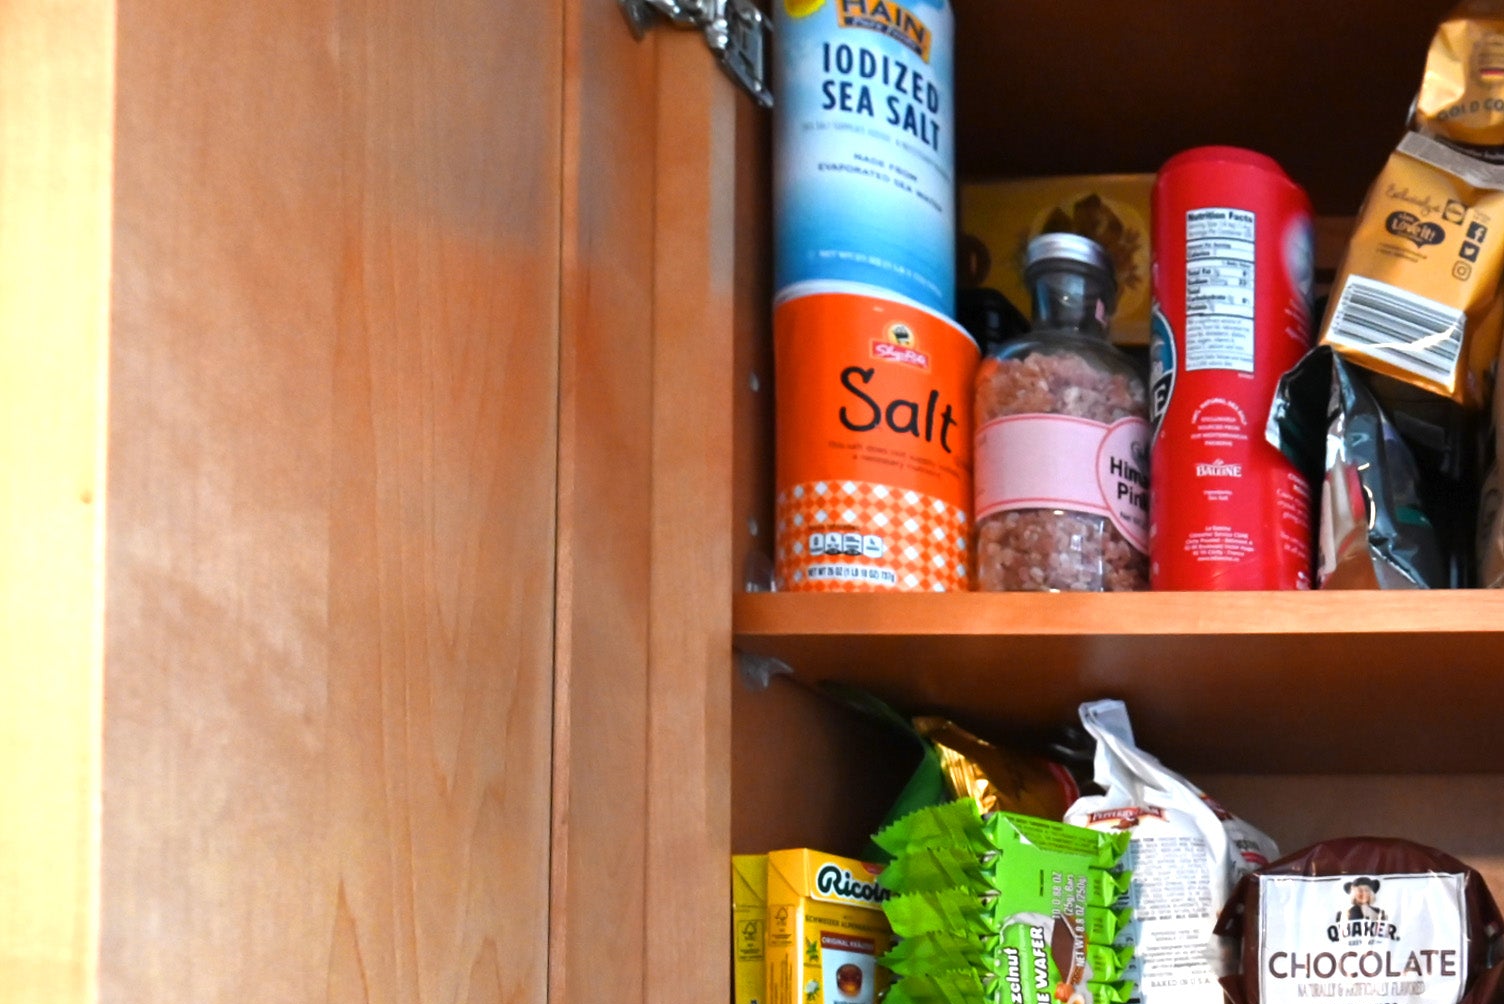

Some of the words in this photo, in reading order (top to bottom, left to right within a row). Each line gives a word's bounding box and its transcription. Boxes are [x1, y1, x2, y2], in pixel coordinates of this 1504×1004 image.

[842, 0, 924, 43] HAIN
[823, 42, 939, 114] IODIZED
[822, 80, 874, 117] SEA
[887, 96, 940, 151] SALT
[1188, 211, 1226, 221] Nutrition
[1228, 211, 1252, 223] Facts
[839, 366, 958, 454] Salt
[1030, 926, 1049, 989] WAFER
[1075, 951, 1086, 967] NET
[1268, 949, 1456, 979] CHOCOLATE
